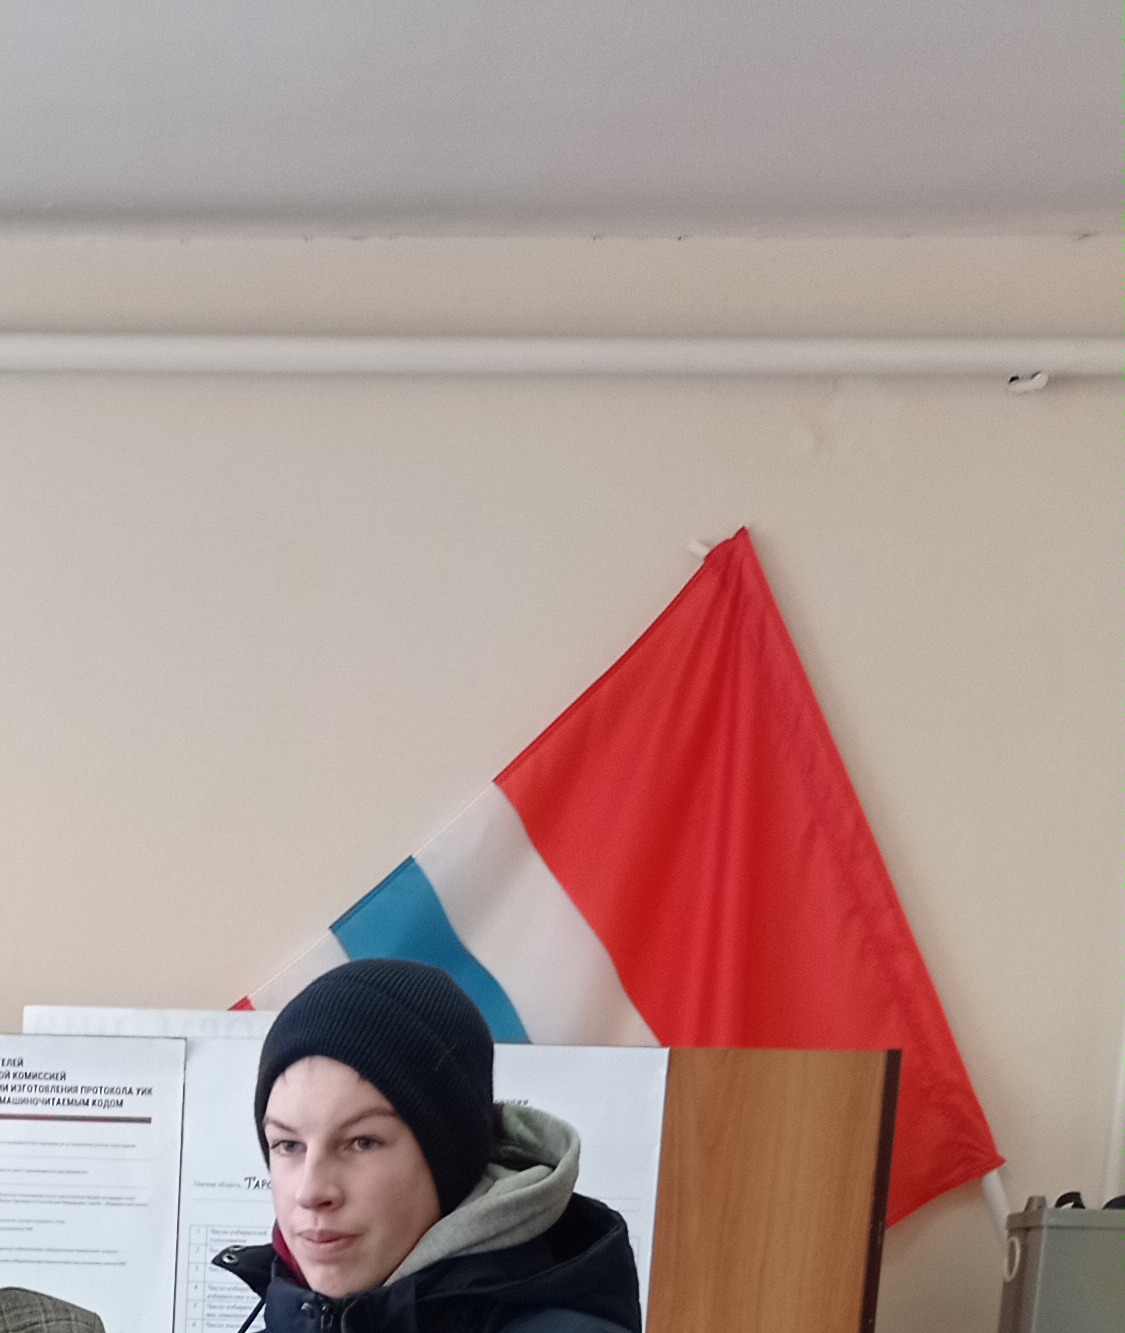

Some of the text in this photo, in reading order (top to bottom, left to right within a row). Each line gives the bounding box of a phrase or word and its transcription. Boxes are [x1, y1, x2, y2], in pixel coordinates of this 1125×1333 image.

[12, 1071, 67, 1081] КОМИССИЕЙ
[11, 1084, 78, 1094] ИЗГОТОВЛЕНИЯ
[80, 1086, 133, 1096] ПРОТОКОЛА
[135, 1087, 154, 1096] УИК
[91, 1098, 124, 1109] КОДОМ
